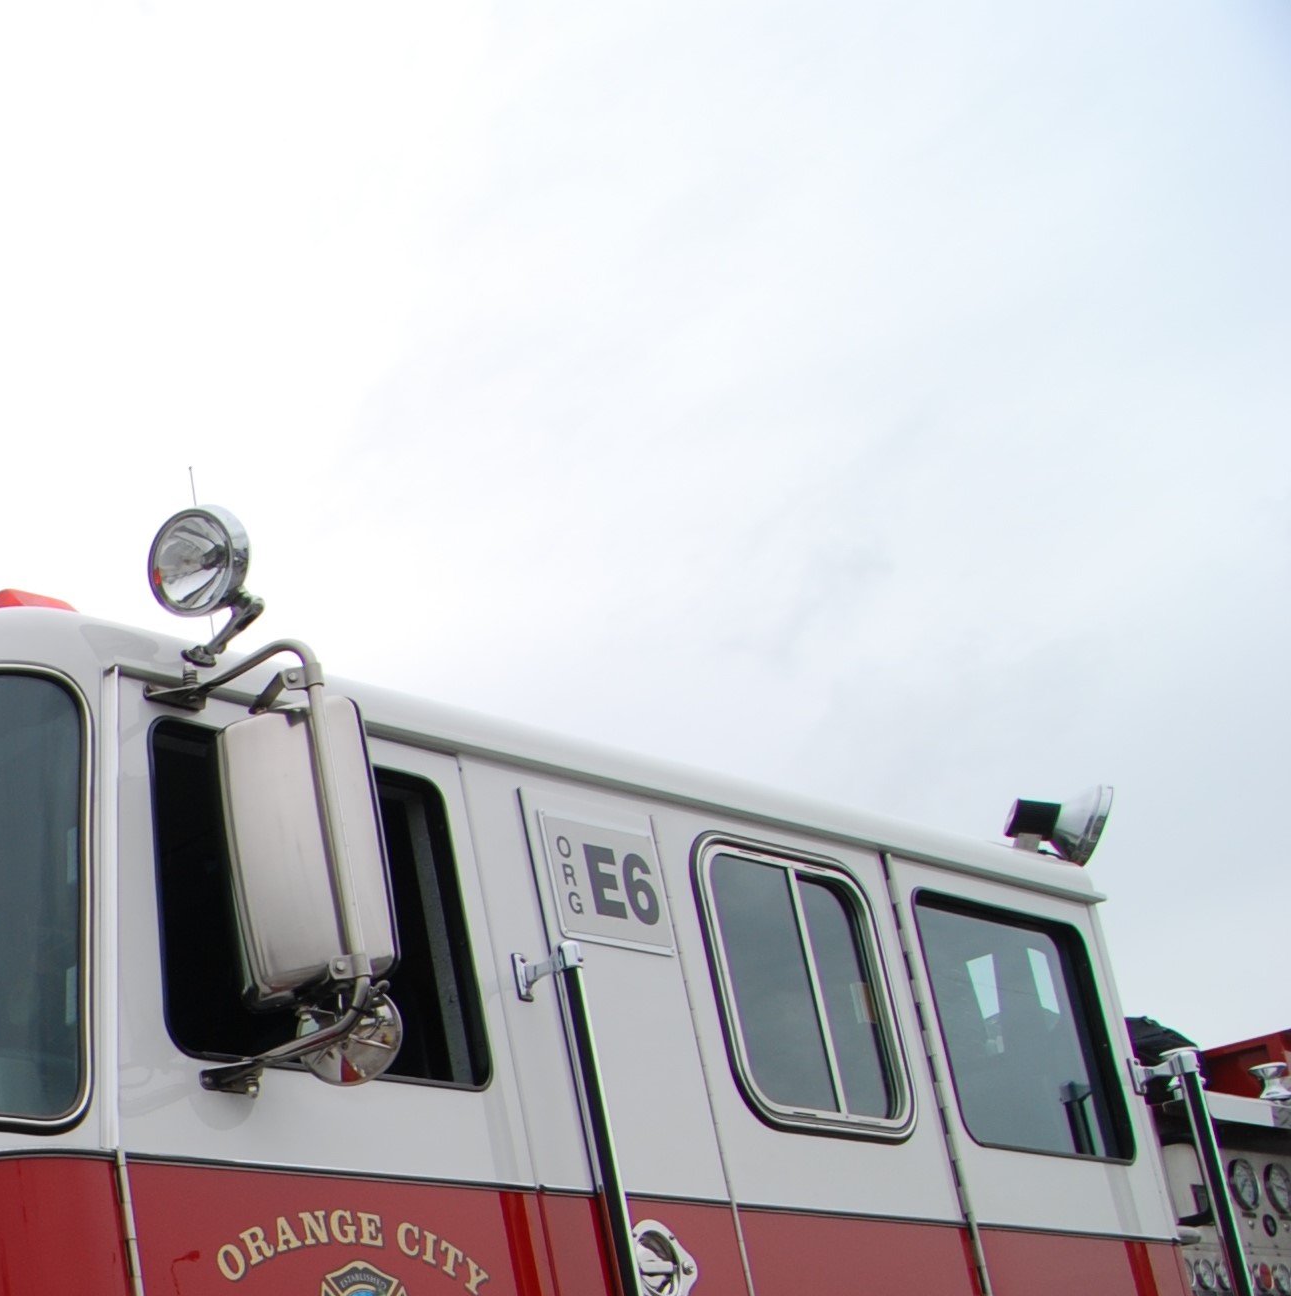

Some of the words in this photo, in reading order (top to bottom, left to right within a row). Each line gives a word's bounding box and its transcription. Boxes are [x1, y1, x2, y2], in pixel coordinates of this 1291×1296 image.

[556, 836, 584, 915] ORG
[582, 843, 660, 926] E6
[217, 1210, 385, 1282] ORANGE
[396, 1221, 490, 1296] CITY
